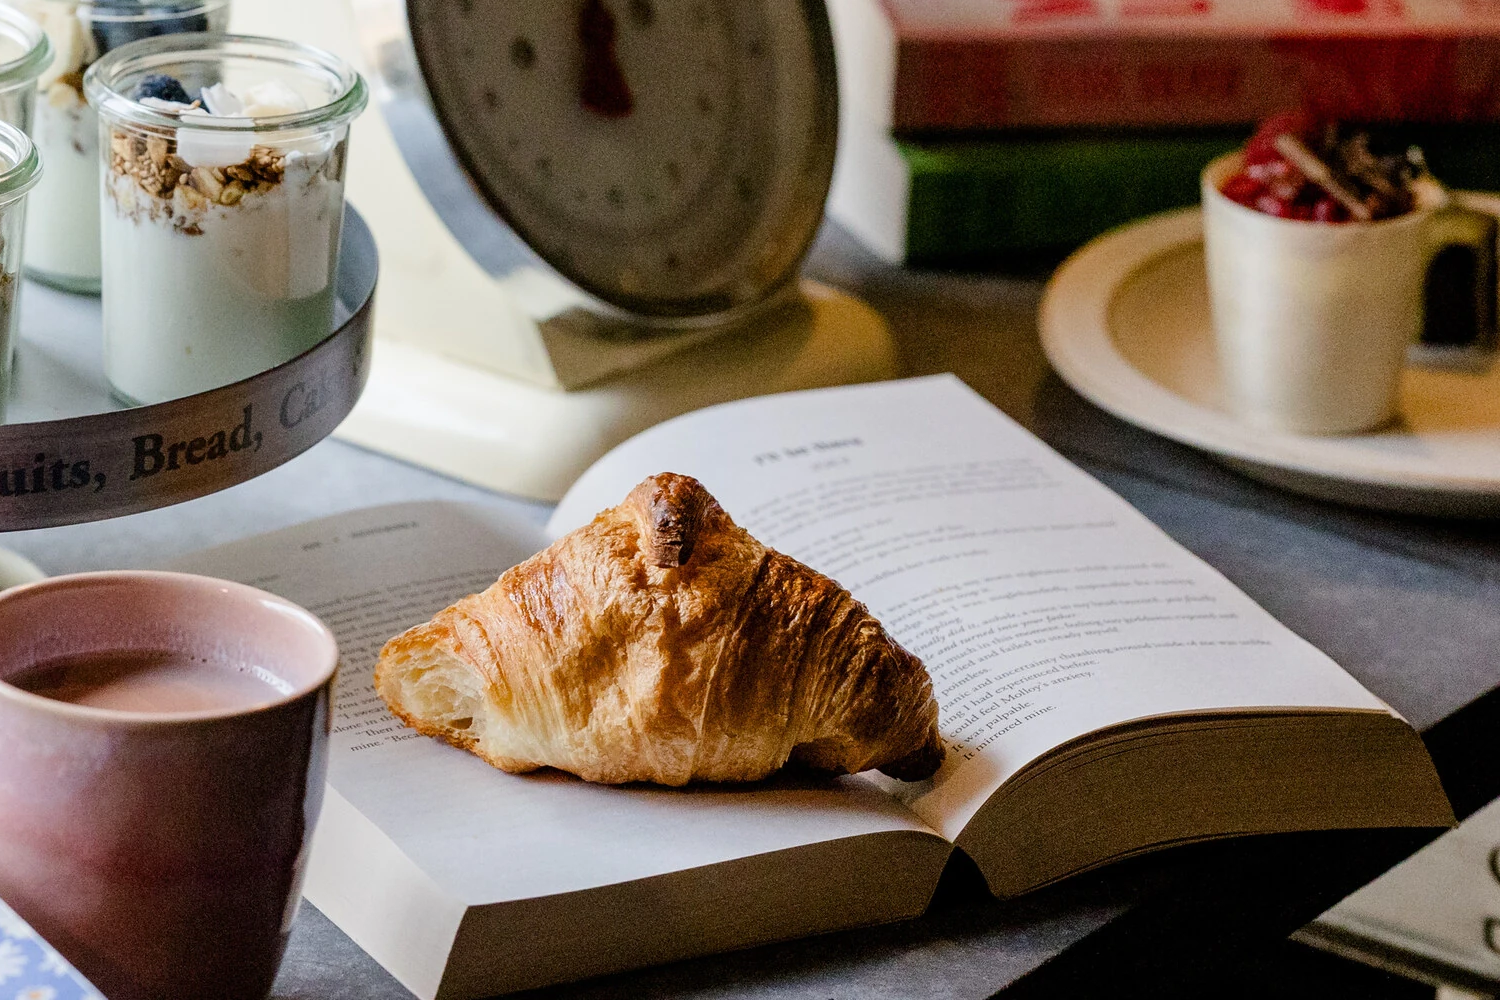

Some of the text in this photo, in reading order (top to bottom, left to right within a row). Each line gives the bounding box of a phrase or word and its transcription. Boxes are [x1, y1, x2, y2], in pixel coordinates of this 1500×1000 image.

[129, 404, 263, 482] Bread,
[929, 664, 945, 674] oo
[946, 649, 977, 667] much
[940, 690, 971, 714] panic
[972, 678, 994, 693] and
[994, 656, 1058, 682] uncertainty
[1058, 647, 1113, 663] thrashing
[940, 667, 993, 697] pointless.
[948, 658, 977, 678] tried
[977, 649, 1000, 665] and
[999, 638, 1033, 655] failed
[938, 709, 966, 731] hing
[971, 691, 993, 707] had
[995, 666, 1060, 695] experienced
[1059, 659, 1101, 673] before.
[949, 713, 980, 738] could
[980, 701, 1001, 717] feel
[1000, 682, 1050, 706] Molloy's
[952, 701, 1035, 754] It was palpable.
[963, 703, 1058, 762] It mirrored mine.
